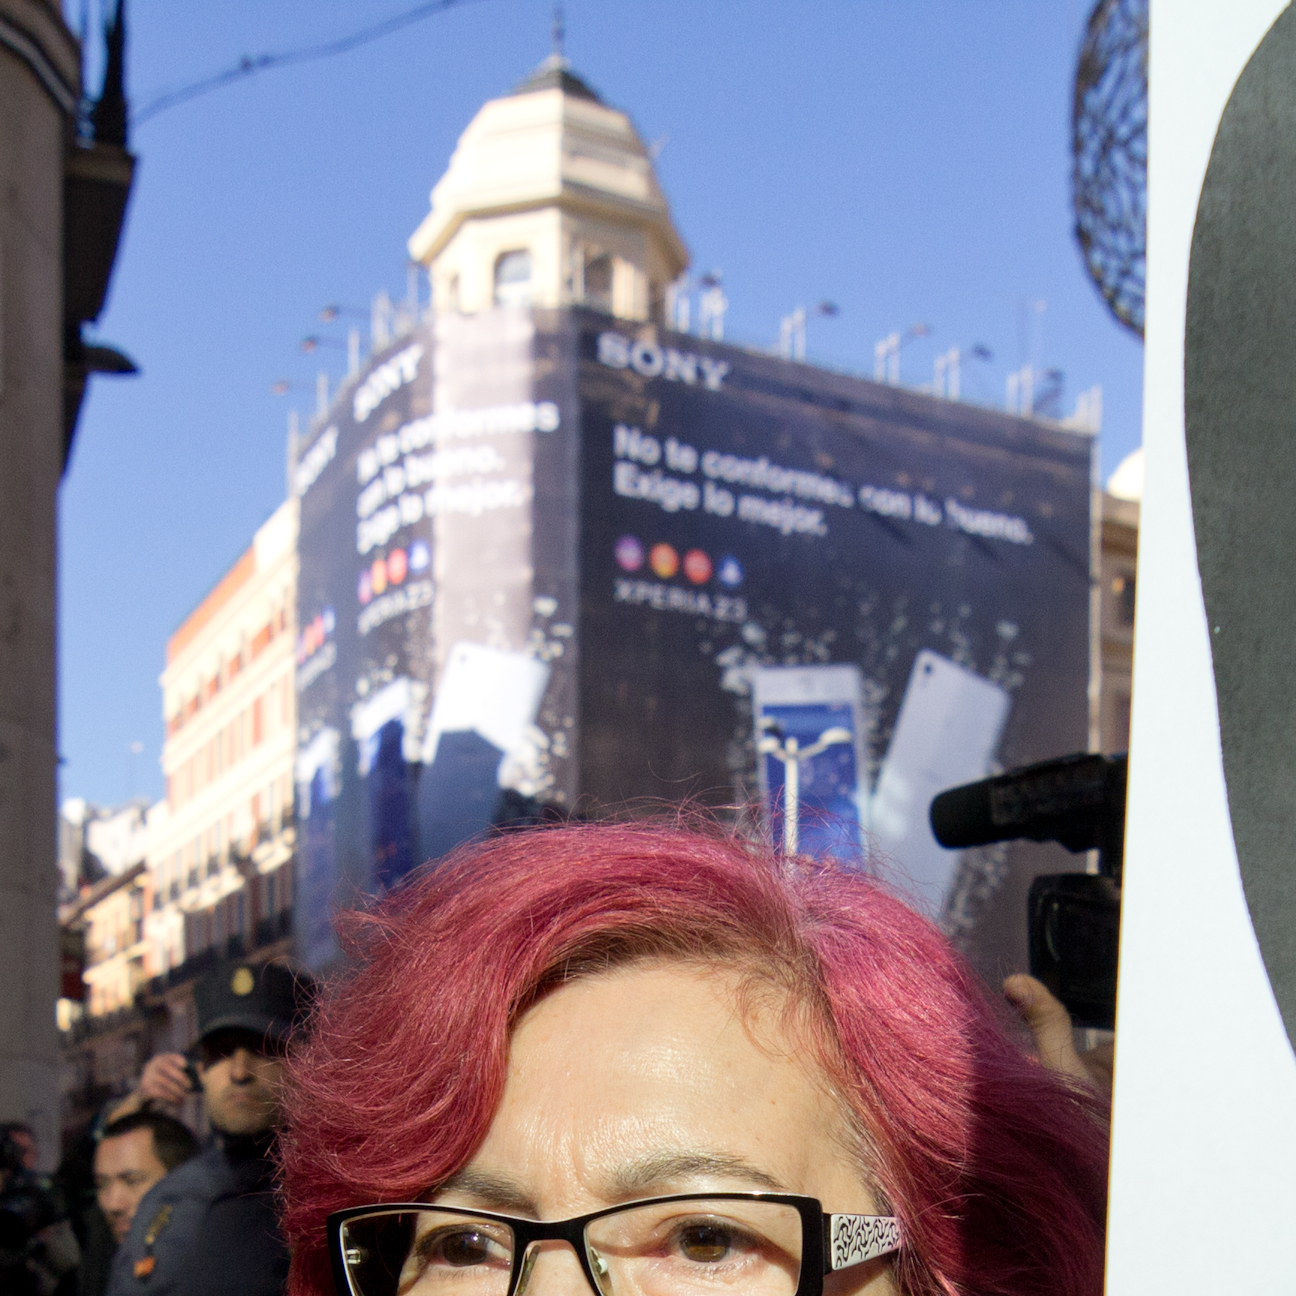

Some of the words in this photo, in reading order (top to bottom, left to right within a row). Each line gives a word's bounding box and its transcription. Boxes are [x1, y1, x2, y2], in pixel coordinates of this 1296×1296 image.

[354, 344, 424, 423] SONY
[597, 332, 730, 391] SONY
[613, 423, 661, 465] No
[664, 436, 699, 473] te
[702, 450, 854, 508] conformes
[858, 484, 912, 521] con
[613, 460, 700, 513] Exige
[703, 479, 736, 517] lo
[737, 494, 828, 536] mejor.
[613, 577, 712, 616] XPERIA
